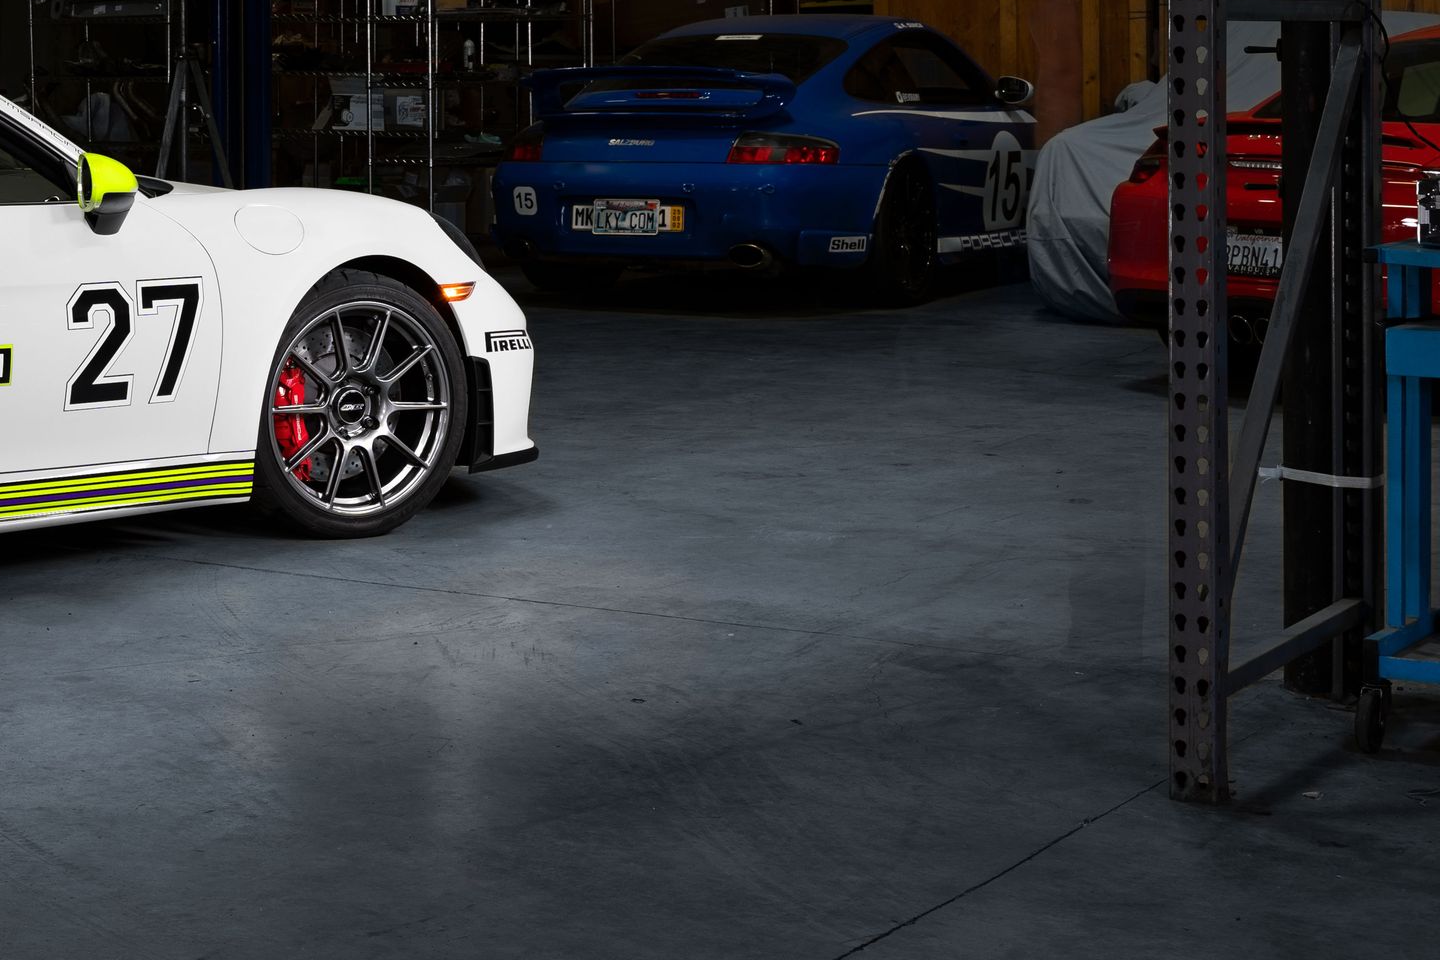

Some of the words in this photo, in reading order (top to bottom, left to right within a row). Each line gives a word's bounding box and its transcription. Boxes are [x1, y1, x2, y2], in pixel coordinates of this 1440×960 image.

[990, 151, 1021, 221] 15
[516, 192, 534, 209] 15
[597, 211, 621, 229] LKY
[630, 212, 655, 230] COM
[831, 238, 865, 251] Shell
[66, 279, 202, 408] 27
[485, 330, 532, 353] PIRELLI
